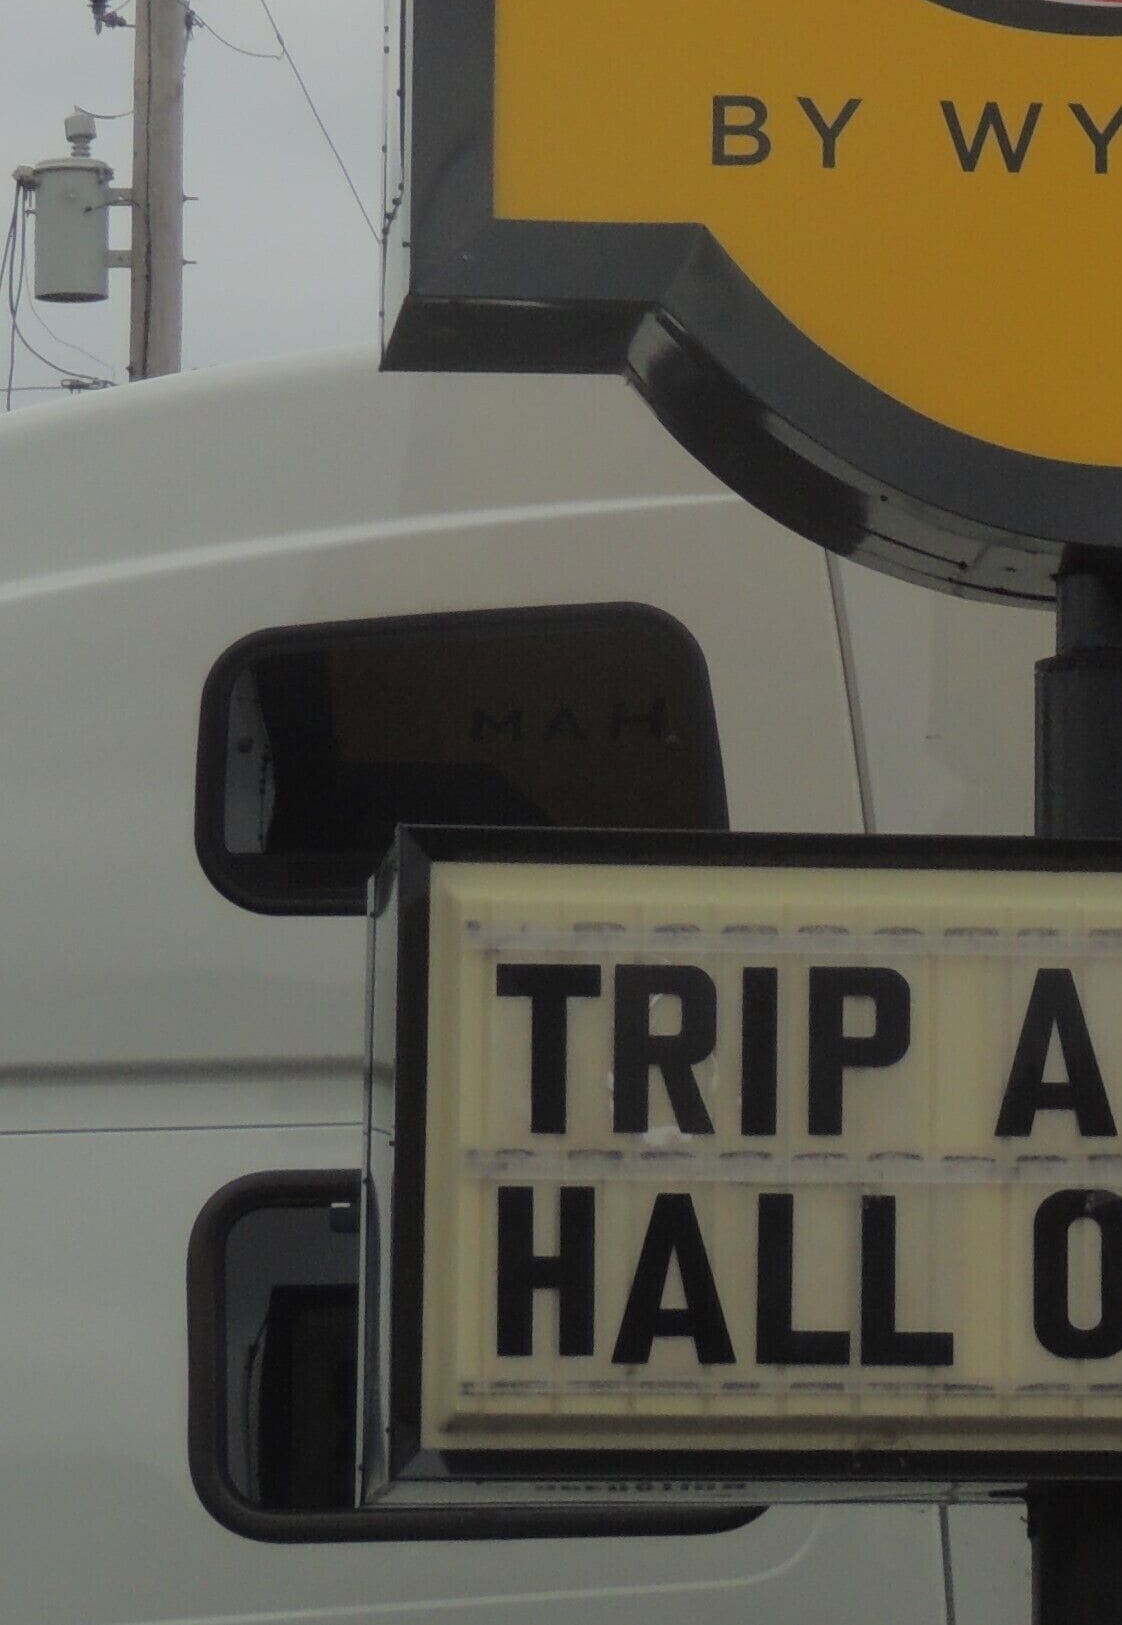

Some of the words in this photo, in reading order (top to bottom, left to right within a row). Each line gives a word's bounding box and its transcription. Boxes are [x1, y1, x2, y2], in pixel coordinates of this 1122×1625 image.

[711, 95, 862, 169] BY
[495, 963, 911, 1138] TRIP
[496, 1185, 955, 1371] HALL
